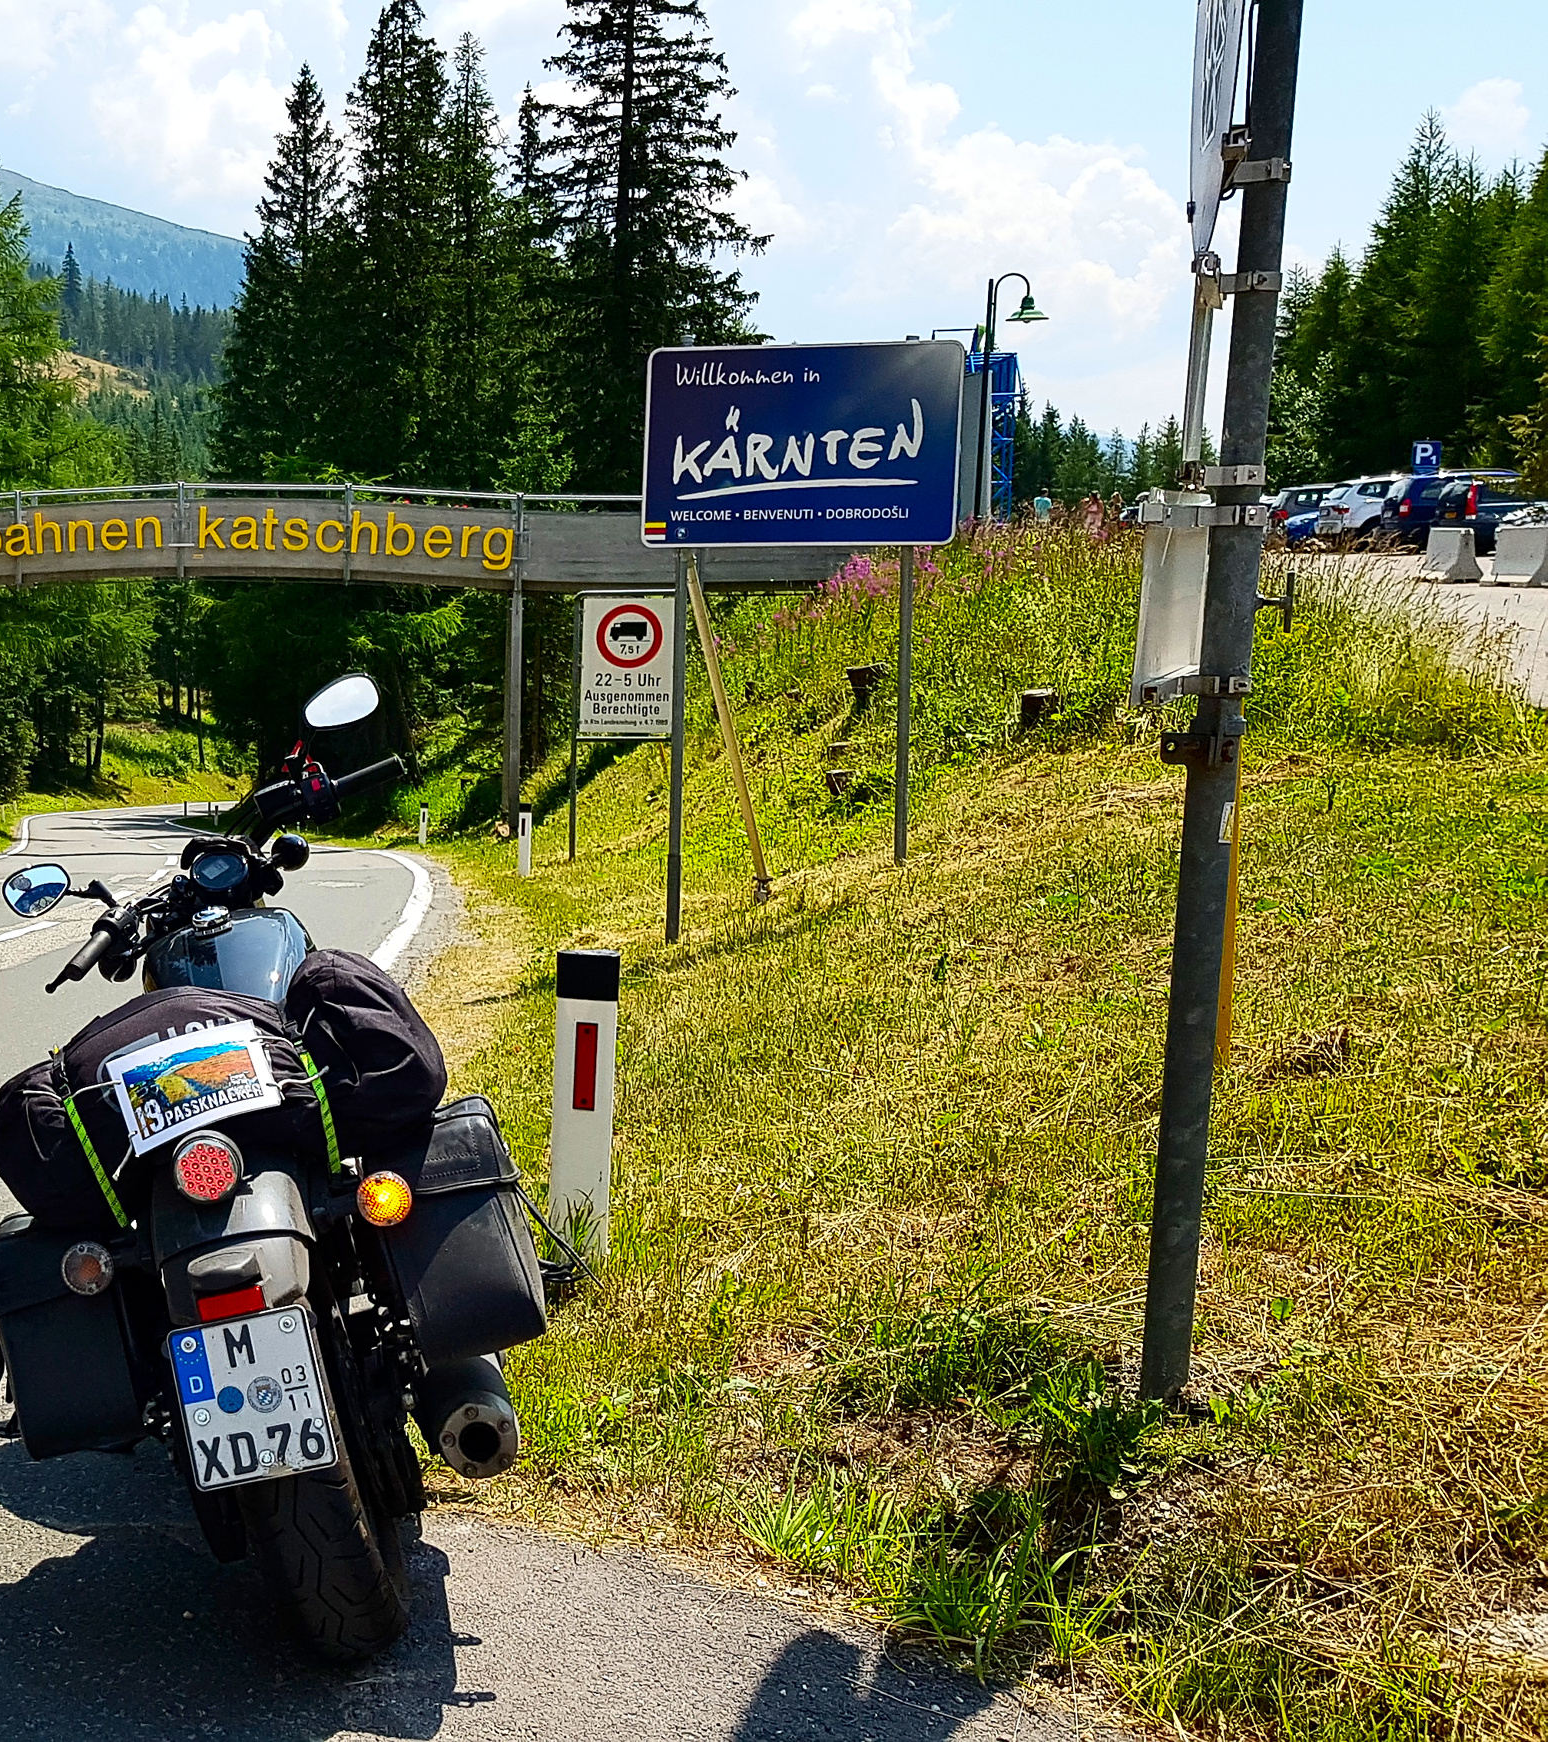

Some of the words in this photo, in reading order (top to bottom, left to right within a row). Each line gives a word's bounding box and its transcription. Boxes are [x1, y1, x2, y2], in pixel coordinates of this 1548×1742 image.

[675, 363, 794, 386] Willkommen
[804, 368, 820, 383] in
[673, 398, 924, 484] KÄRNTEN
[670, 510, 732, 521] WELCOME
[743, 509, 814, 520] BENVENUTI
[826, 504, 909, 520] DOBRODOŠLI
[199, 506, 515, 571] katschberg
[638, 673, 661, 687] Uhr
[584, 689, 669, 703] Ausgenommen
[593, 703, 660, 717] Berechtigte
[165, 1083, 264, 1126] PASSKNACKER
[223, 1324, 256, 1368] M
[281, 1365, 307, 1384] 03
[189, 1376, 204, 1394] D
[289, 1391, 311, 1411] 11
